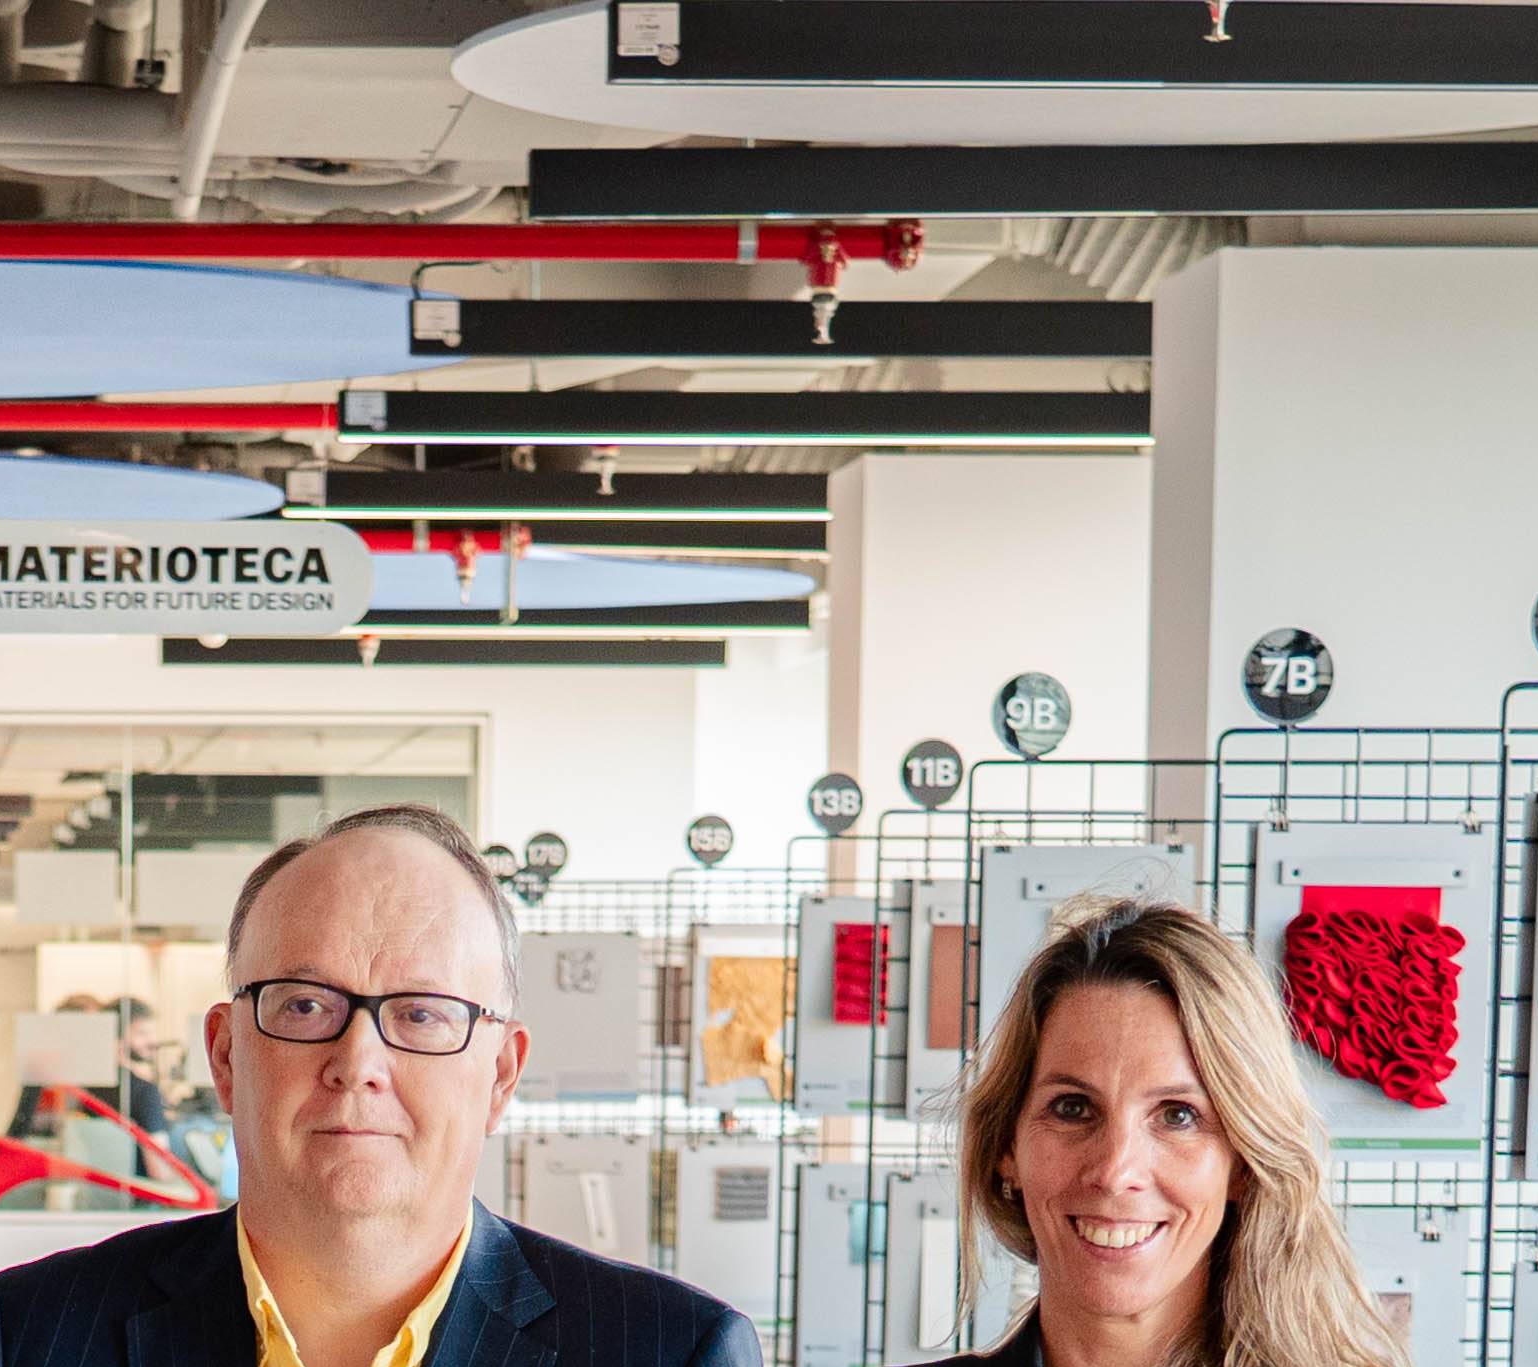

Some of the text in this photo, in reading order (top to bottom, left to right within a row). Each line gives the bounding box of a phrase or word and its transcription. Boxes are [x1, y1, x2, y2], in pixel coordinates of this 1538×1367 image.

[103, 591, 147, 610] FOR
[154, 591, 241, 610] FUTURE
[249, 592, 333, 611] DESIGN
[1260, 654, 1316, 696] 7B
[1006, 696, 1057, 731] 9B
[906, 757, 959, 787] 11B
[810, 789, 860, 816] 13B
